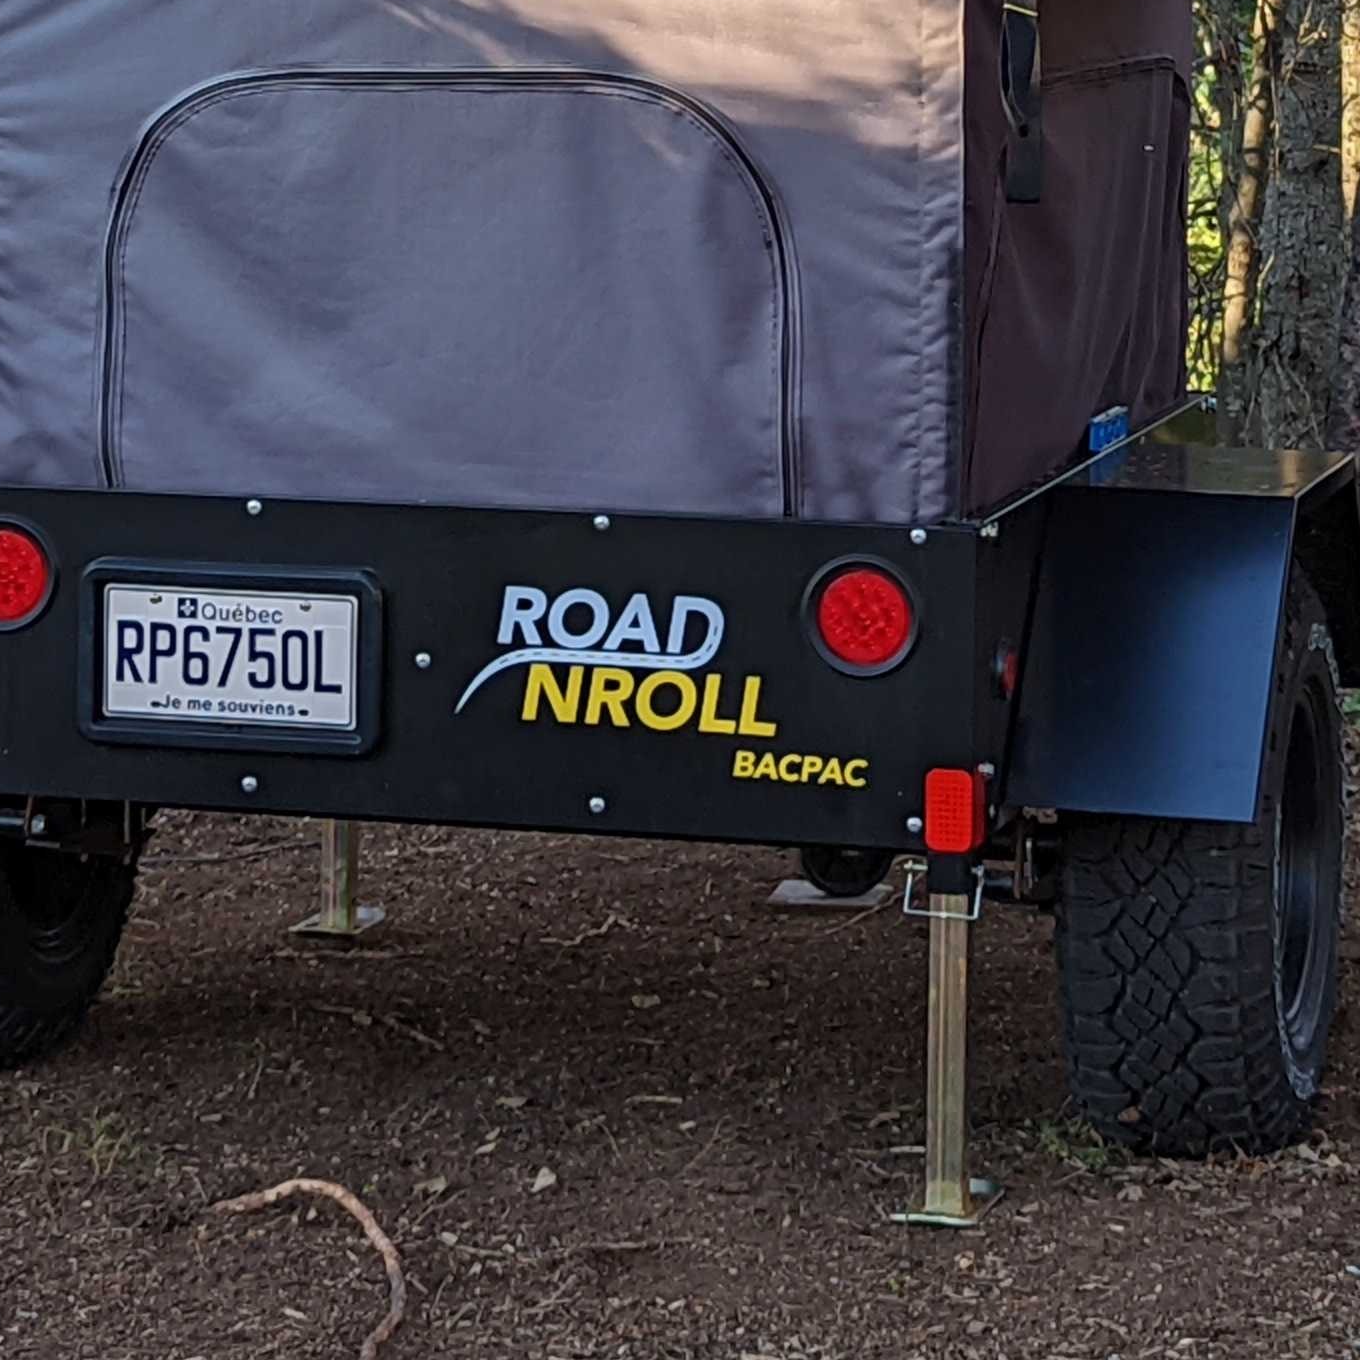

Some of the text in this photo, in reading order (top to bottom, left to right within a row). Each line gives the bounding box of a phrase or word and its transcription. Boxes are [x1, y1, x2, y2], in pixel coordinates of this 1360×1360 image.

[201, 602, 284, 625] Québec
[496, 584, 726, 659] ROAD
[114, 619, 344, 695] RP6750L
[161, 694, 296, 717] Je me souviens
[521, 662, 778, 738] NROLL
[732, 750, 870, 787] BACPAC
